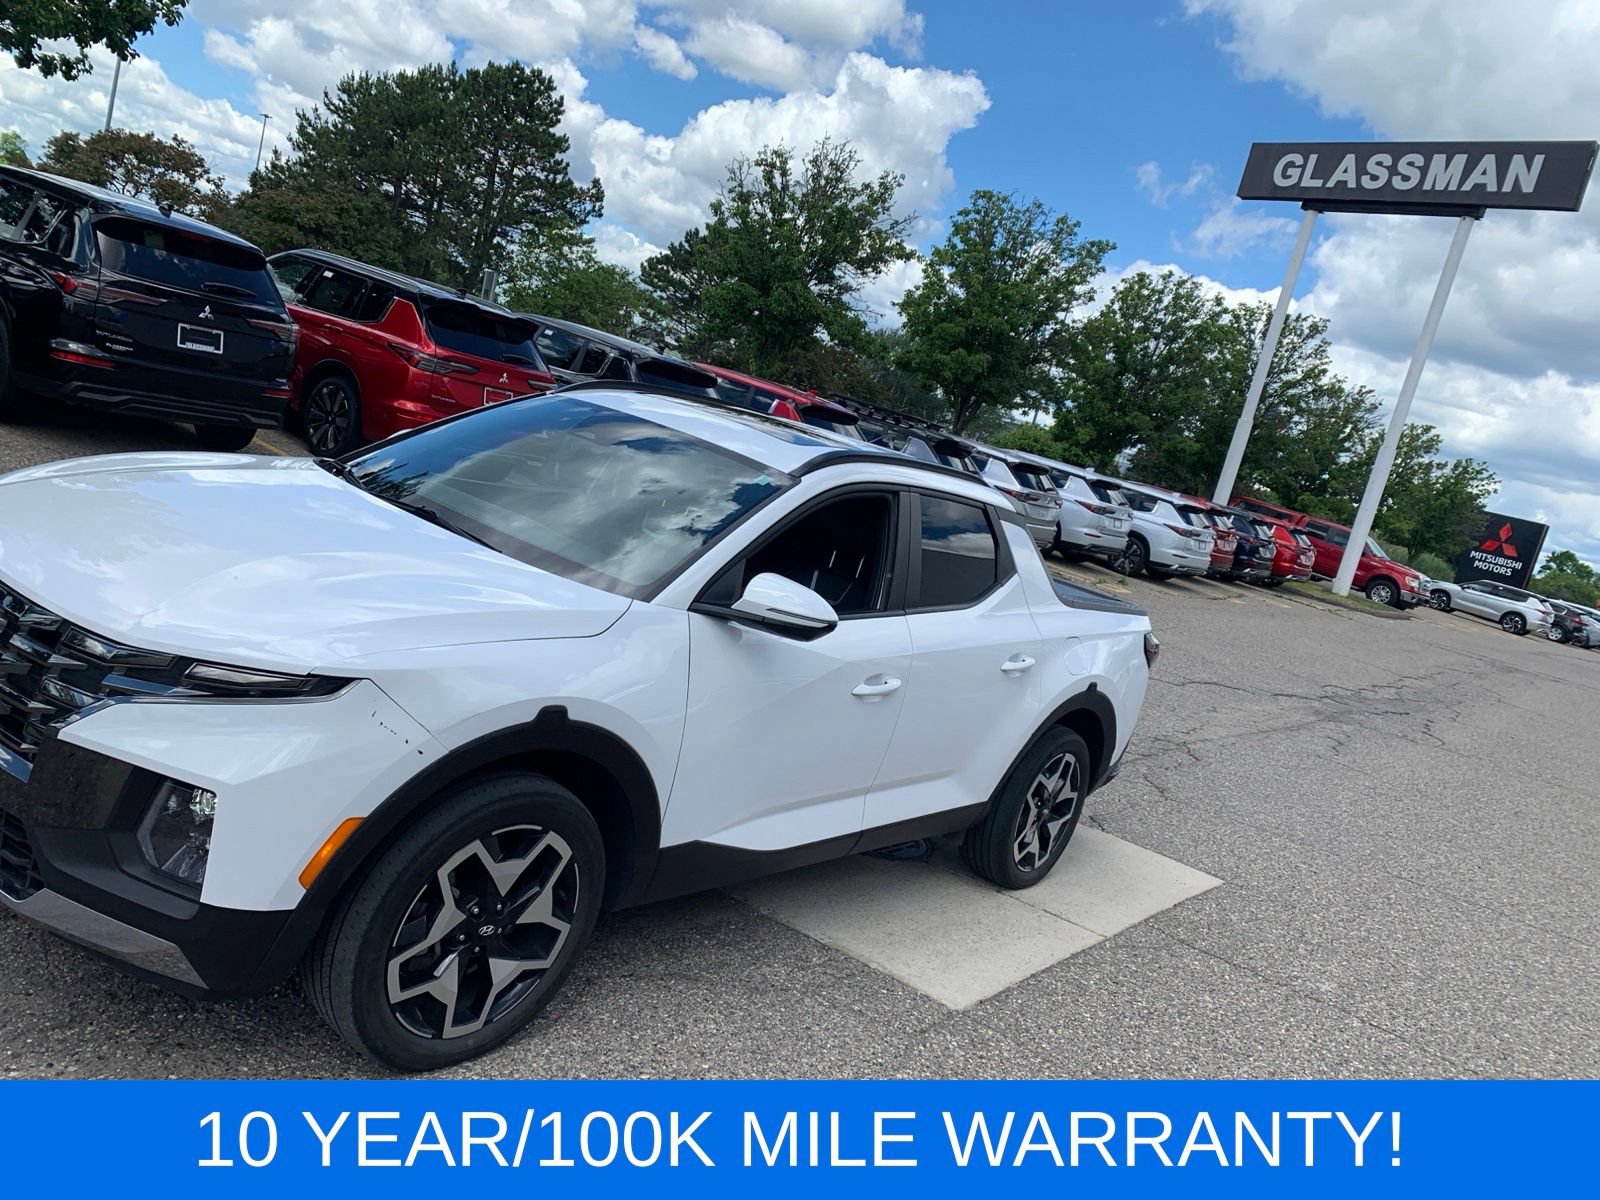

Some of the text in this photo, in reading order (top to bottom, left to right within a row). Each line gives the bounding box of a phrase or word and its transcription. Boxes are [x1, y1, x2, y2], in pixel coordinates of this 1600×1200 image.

[1273, 153, 1546, 193] GLASSMAN
[1469, 550, 1523, 570] MITSUBISHI
[1473, 560, 1512, 576] MOTORS
